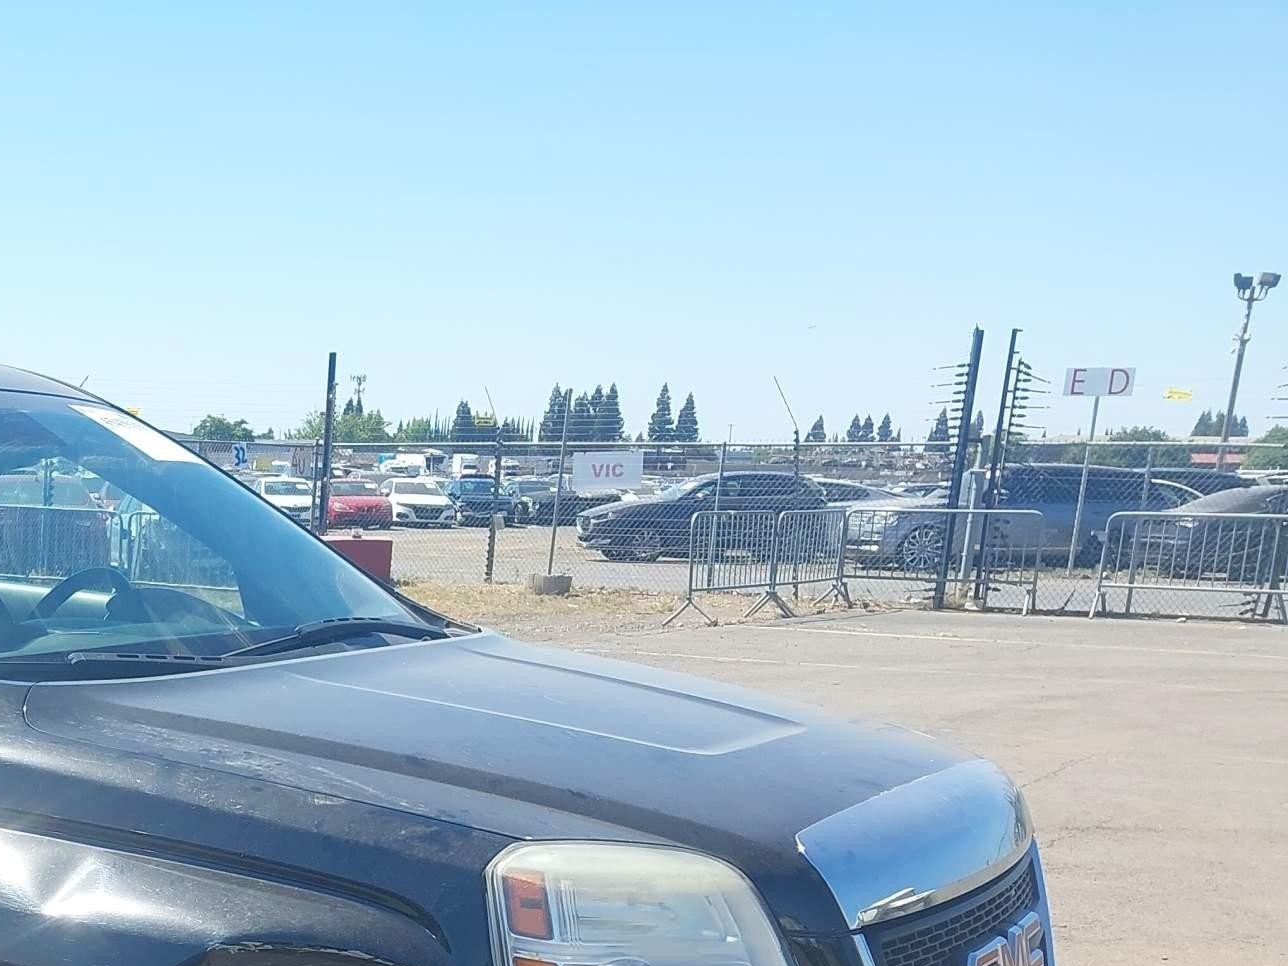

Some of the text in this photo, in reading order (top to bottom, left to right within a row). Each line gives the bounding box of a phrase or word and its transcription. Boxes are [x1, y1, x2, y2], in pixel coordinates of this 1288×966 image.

[1070, 368, 1130, 395] E D
[233, 446, 248, 466] 32
[592, 463, 624, 478] VIC
